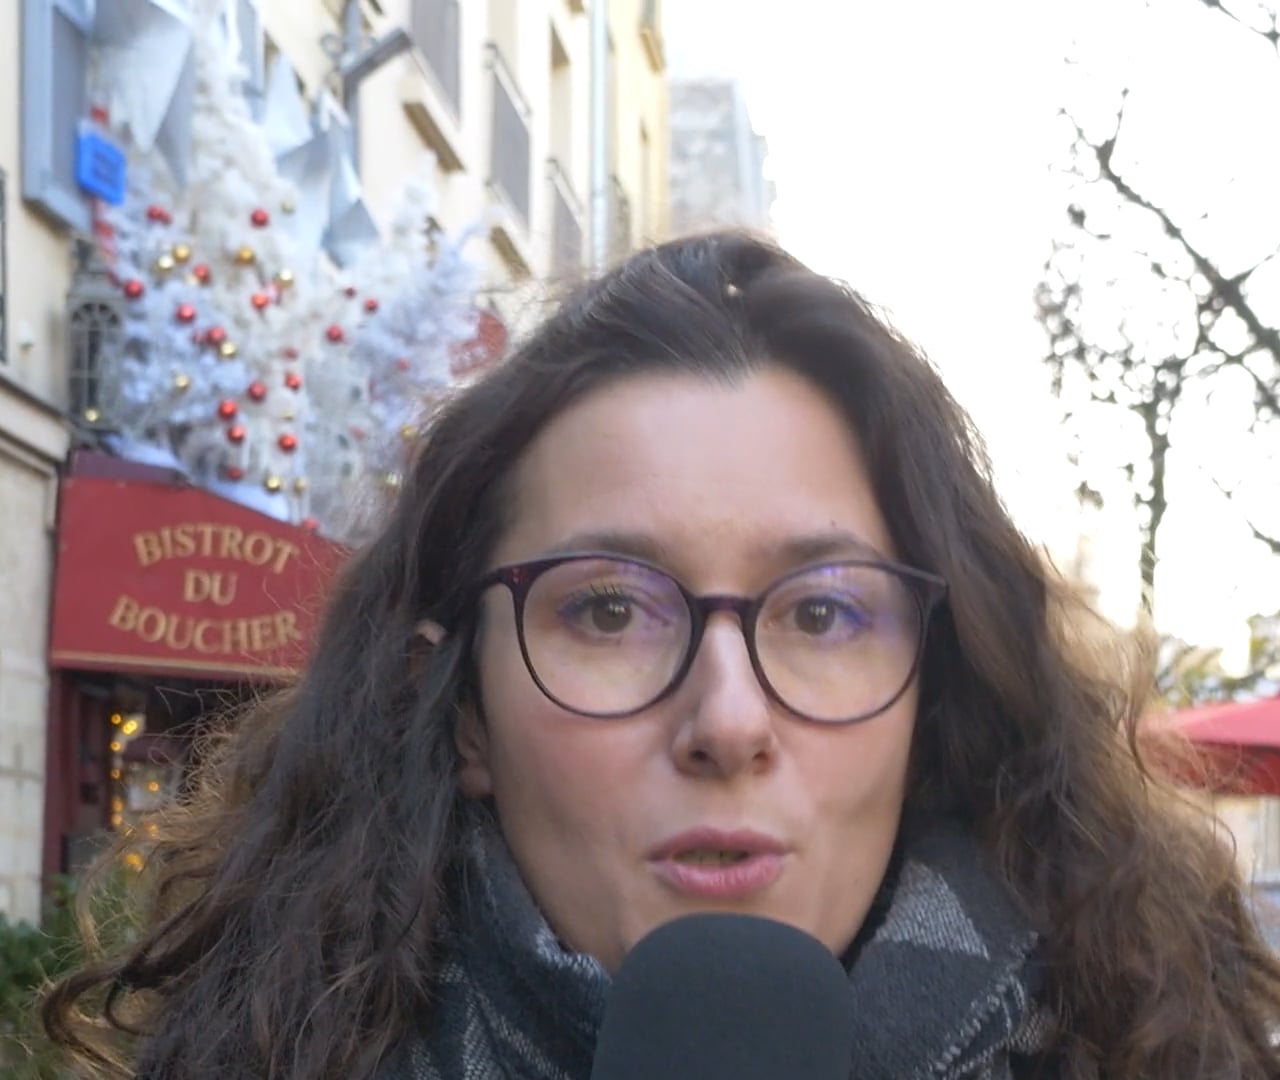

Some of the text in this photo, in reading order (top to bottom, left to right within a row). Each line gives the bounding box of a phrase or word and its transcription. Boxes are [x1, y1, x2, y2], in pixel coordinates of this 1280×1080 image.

[133, 523, 300, 575] BISTROT
[183, 569, 238, 606] DU
[109, 595, 302, 653] BOUCHER
